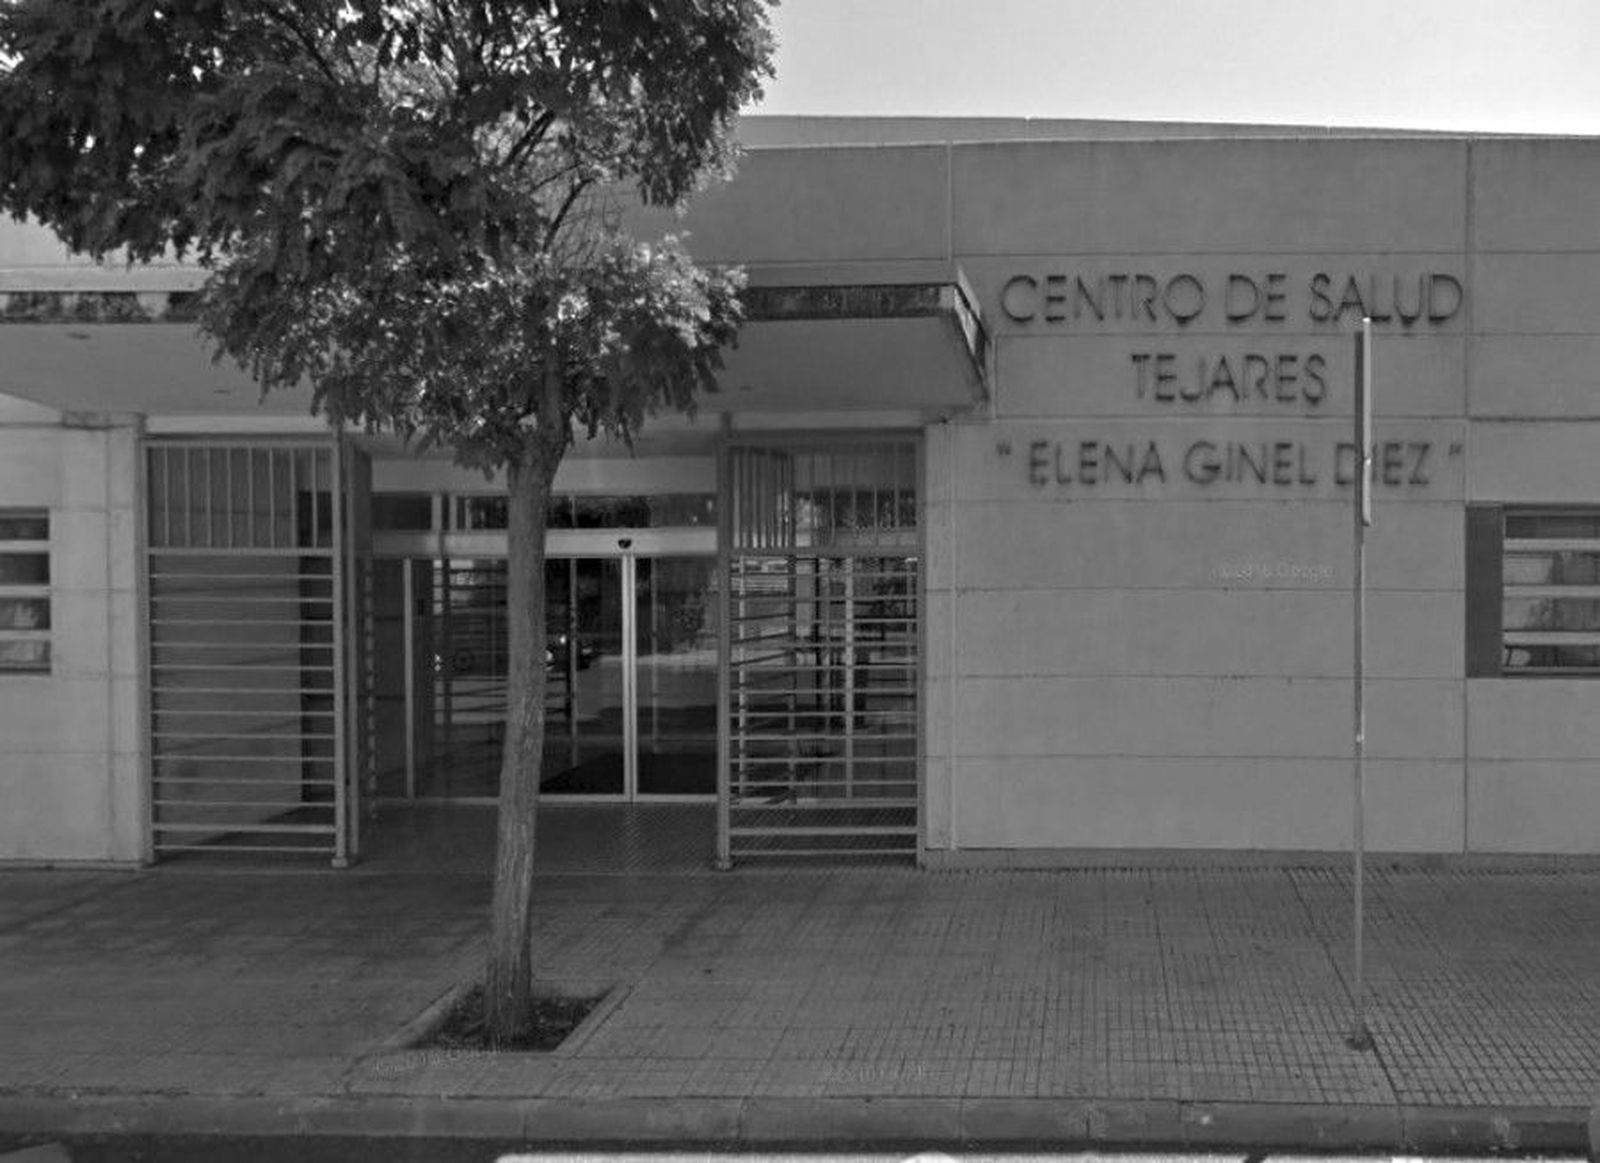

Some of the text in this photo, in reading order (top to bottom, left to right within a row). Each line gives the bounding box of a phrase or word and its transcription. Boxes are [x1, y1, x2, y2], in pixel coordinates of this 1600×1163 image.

[1001, 273, 1464, 327] CENTRO DE SALUD
[1132, 354, 1327, 404] TEJARES
[1028, 441, 1166, 486] ELENA
[1183, 441, 1317, 486] GINEL
